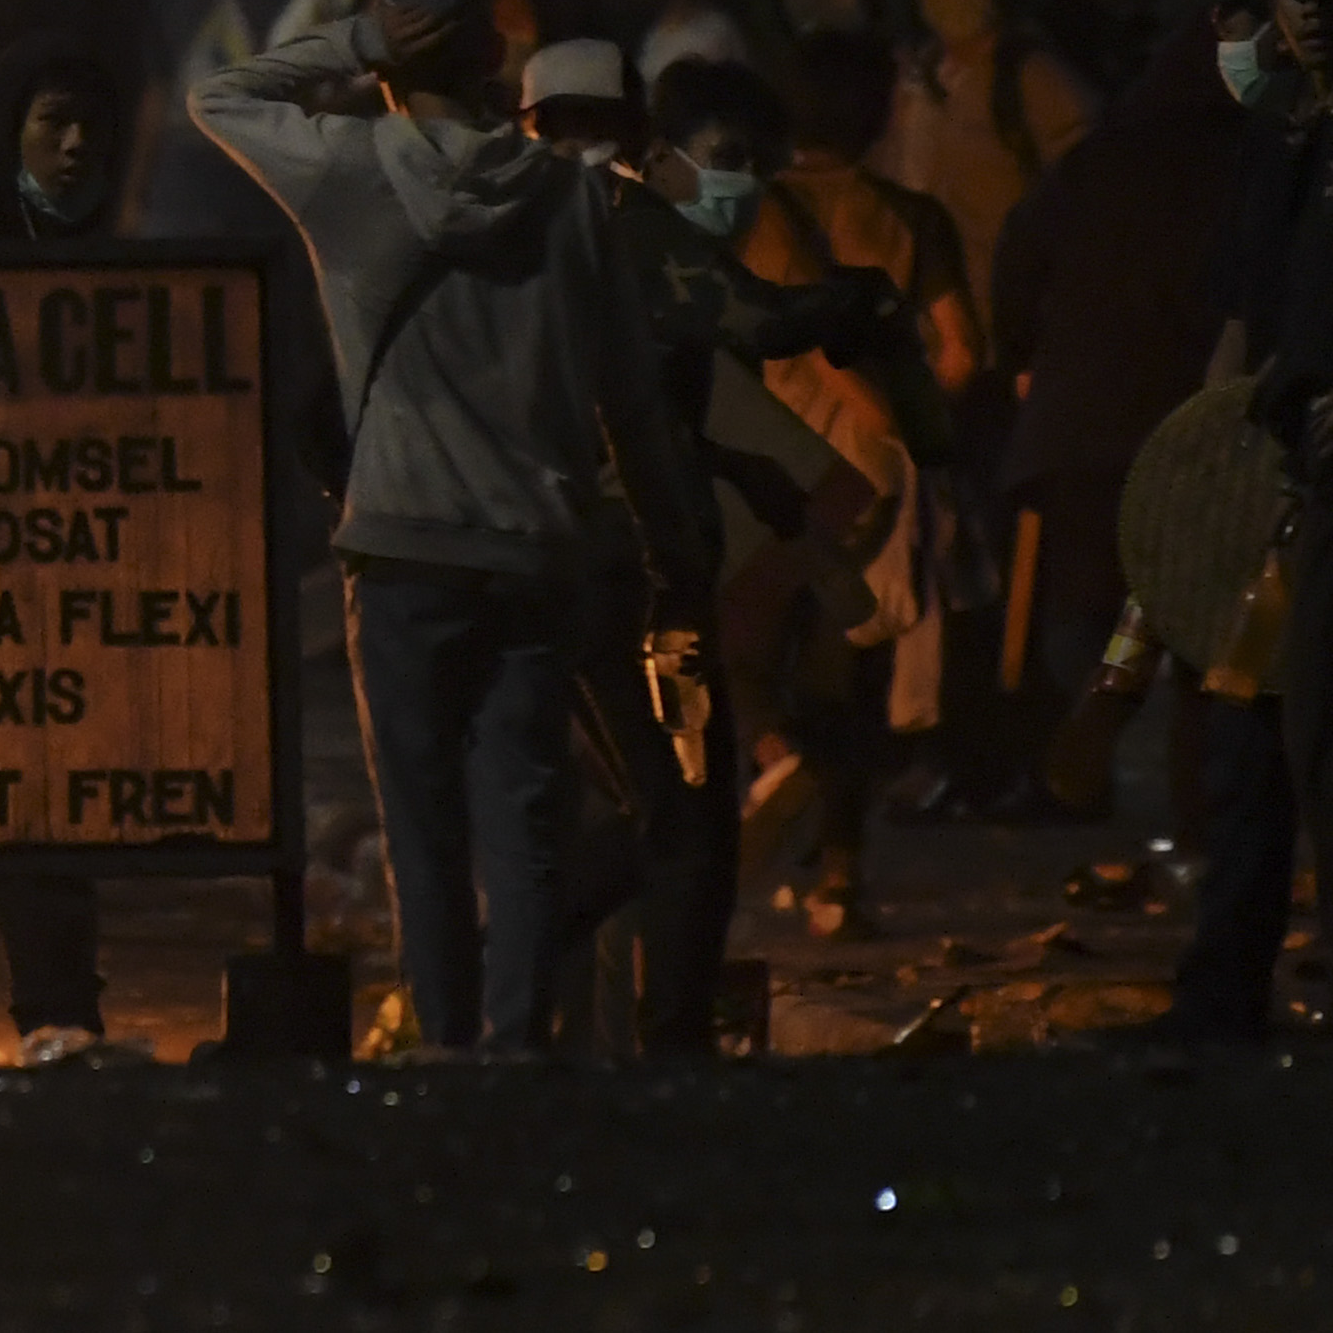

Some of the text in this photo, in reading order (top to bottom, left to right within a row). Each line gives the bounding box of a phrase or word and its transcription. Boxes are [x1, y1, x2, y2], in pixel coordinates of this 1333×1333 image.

[39, 285, 251, 394] CELL
[59, 590, 241, 646] FLEXI
[67, 768, 233, 825] FREN
